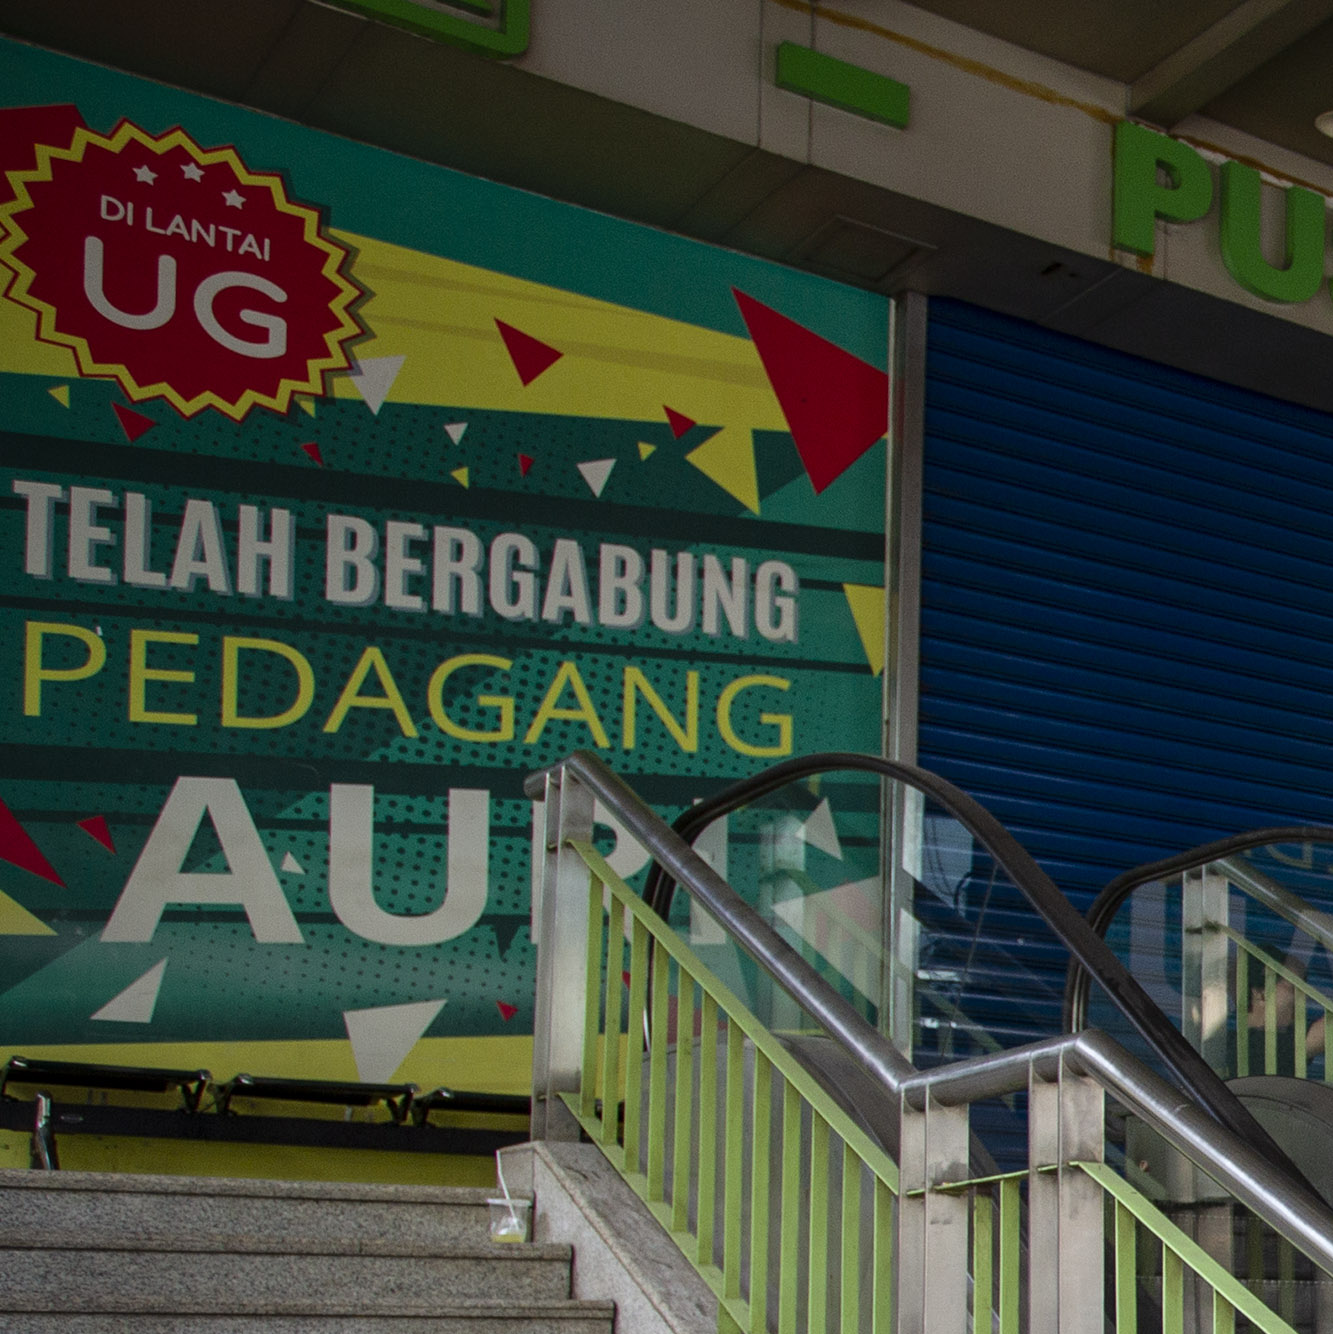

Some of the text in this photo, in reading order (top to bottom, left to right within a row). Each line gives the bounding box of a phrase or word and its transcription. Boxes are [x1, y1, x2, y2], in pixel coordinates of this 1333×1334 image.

[101, 195, 271, 262] DI LANTAI
[83, 236, 288, 358] UG
[12, 480, 797, 643] TELAH BERGABUNG
[22, 620, 794, 757] PEDAGANG
